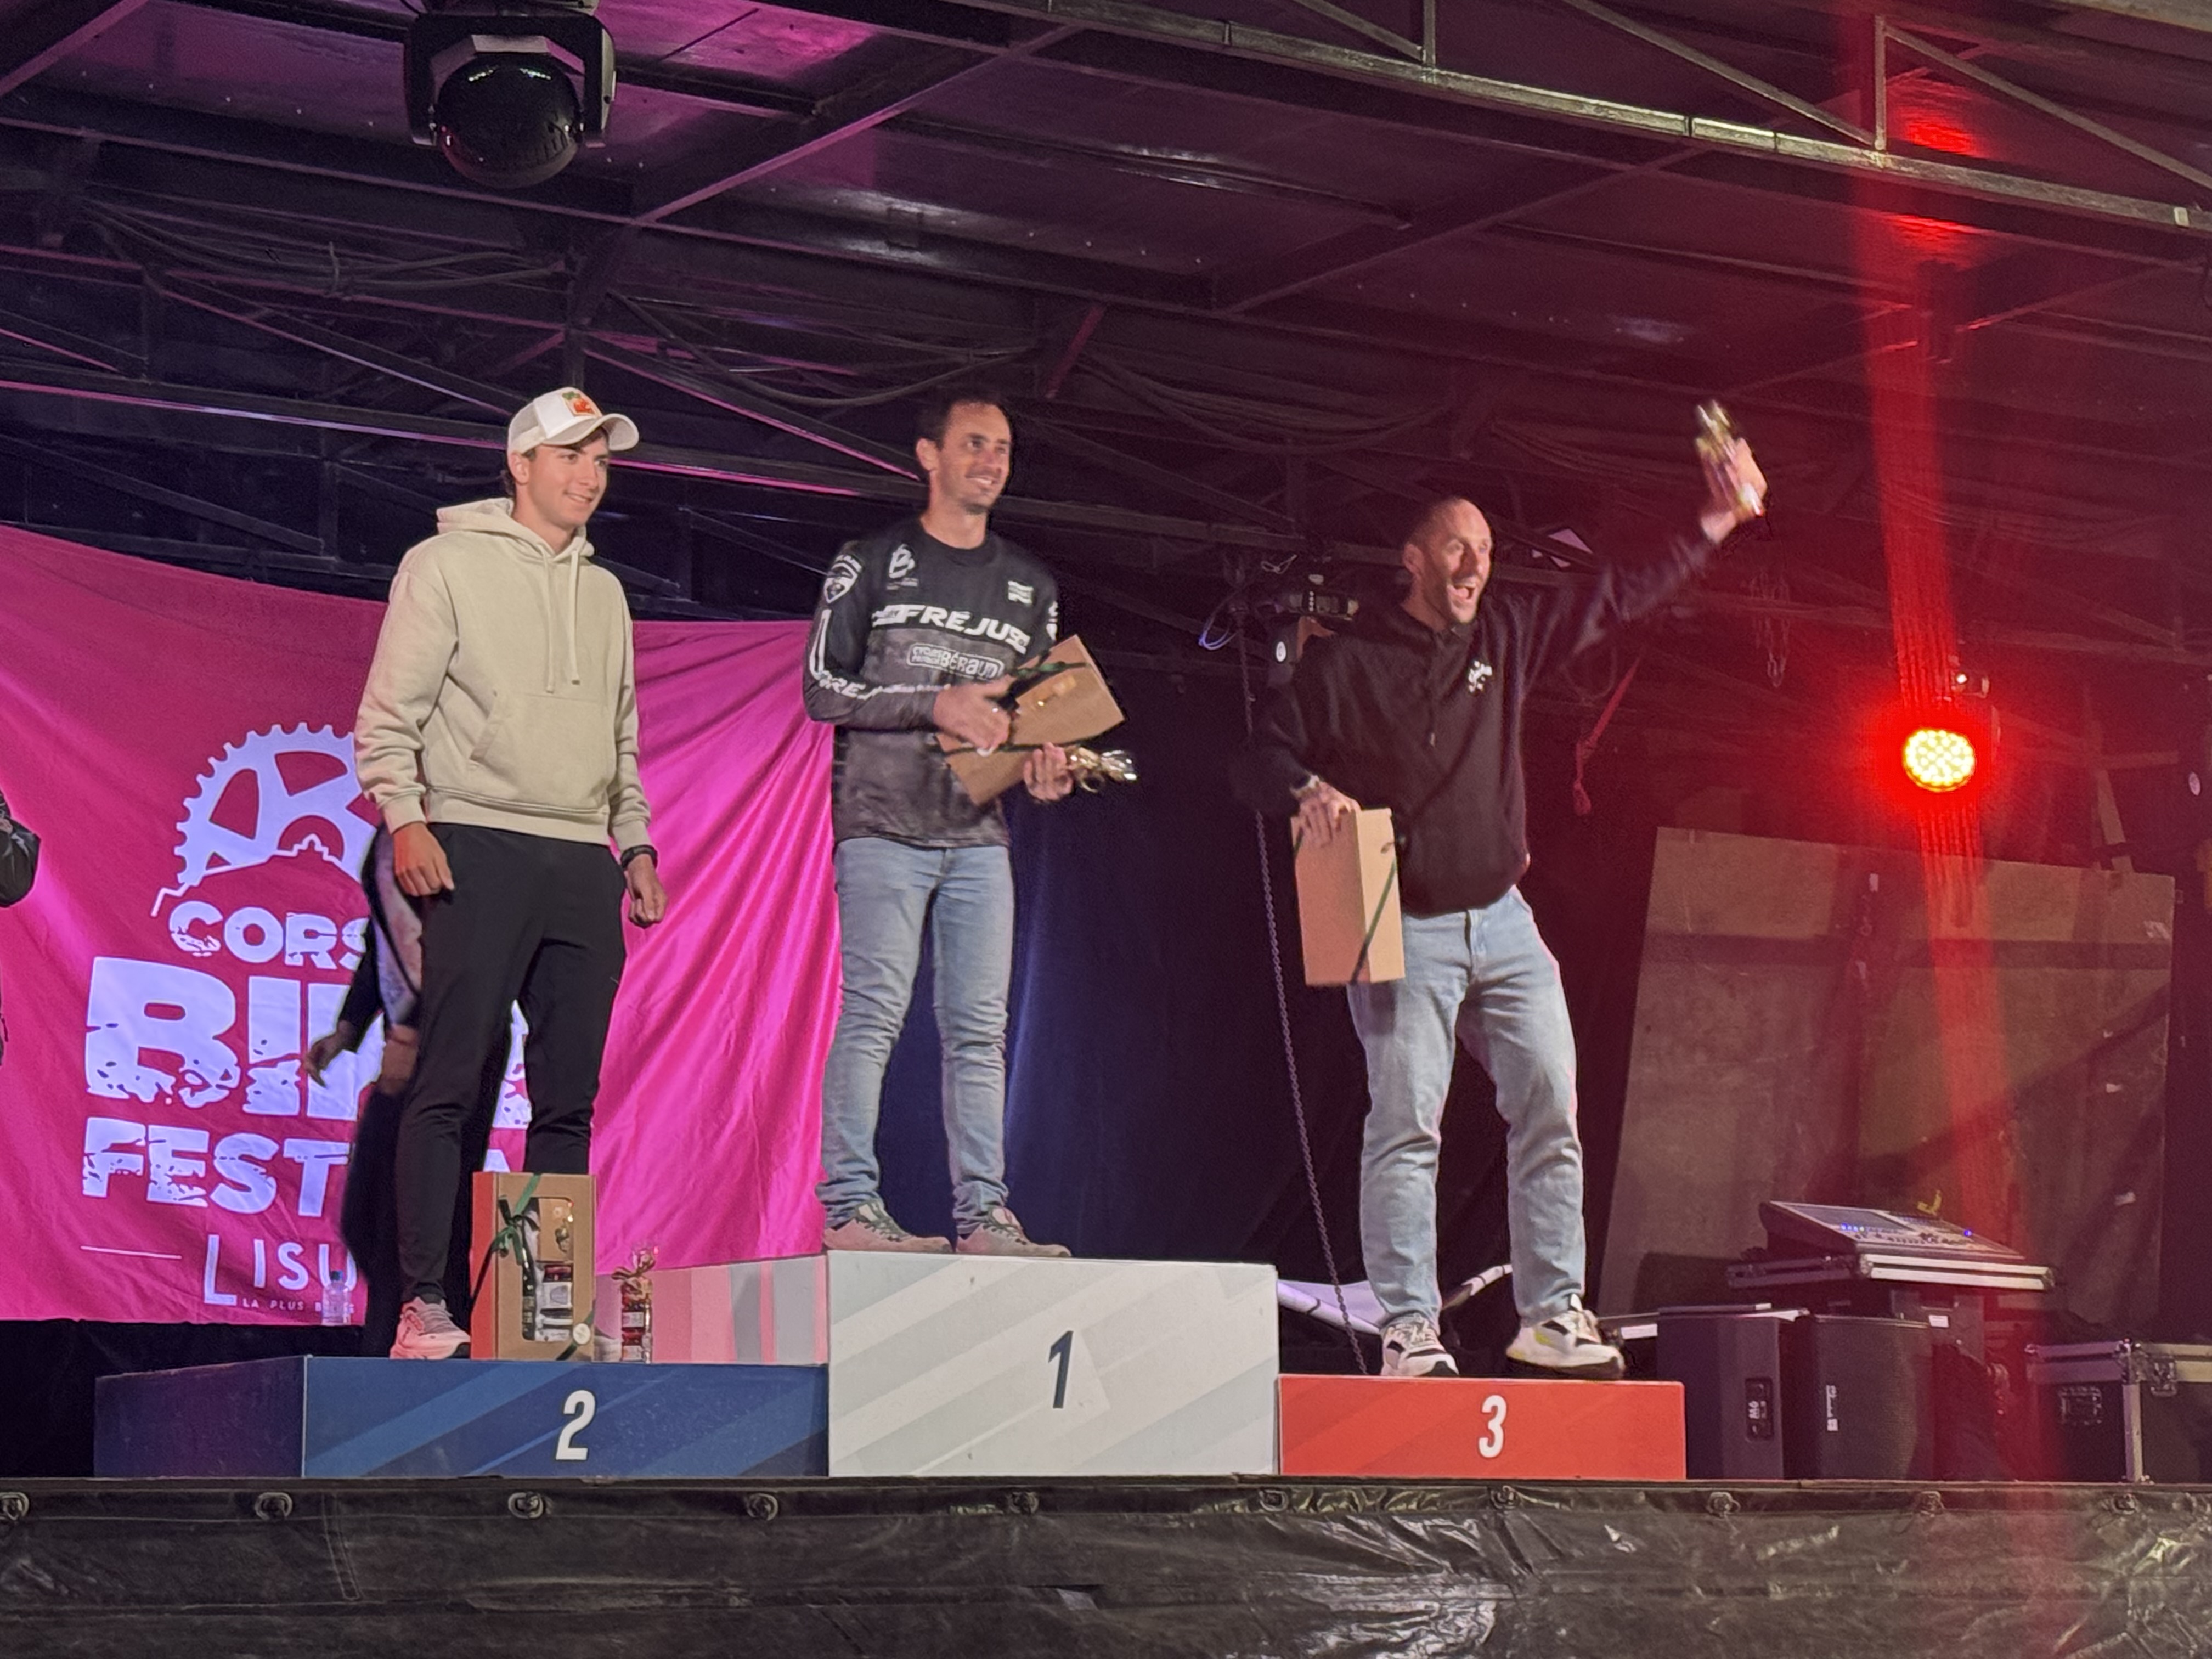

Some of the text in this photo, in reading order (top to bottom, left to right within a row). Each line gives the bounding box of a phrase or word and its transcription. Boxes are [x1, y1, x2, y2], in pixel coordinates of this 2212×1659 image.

[242, 1297, 259, 1308] LA
[270, 1299, 304, 1311] PLUS
[1048, 1330, 1074, 1409] 1
[556, 1390, 596, 1460] 2
[1479, 1395, 1507, 1458] 3
